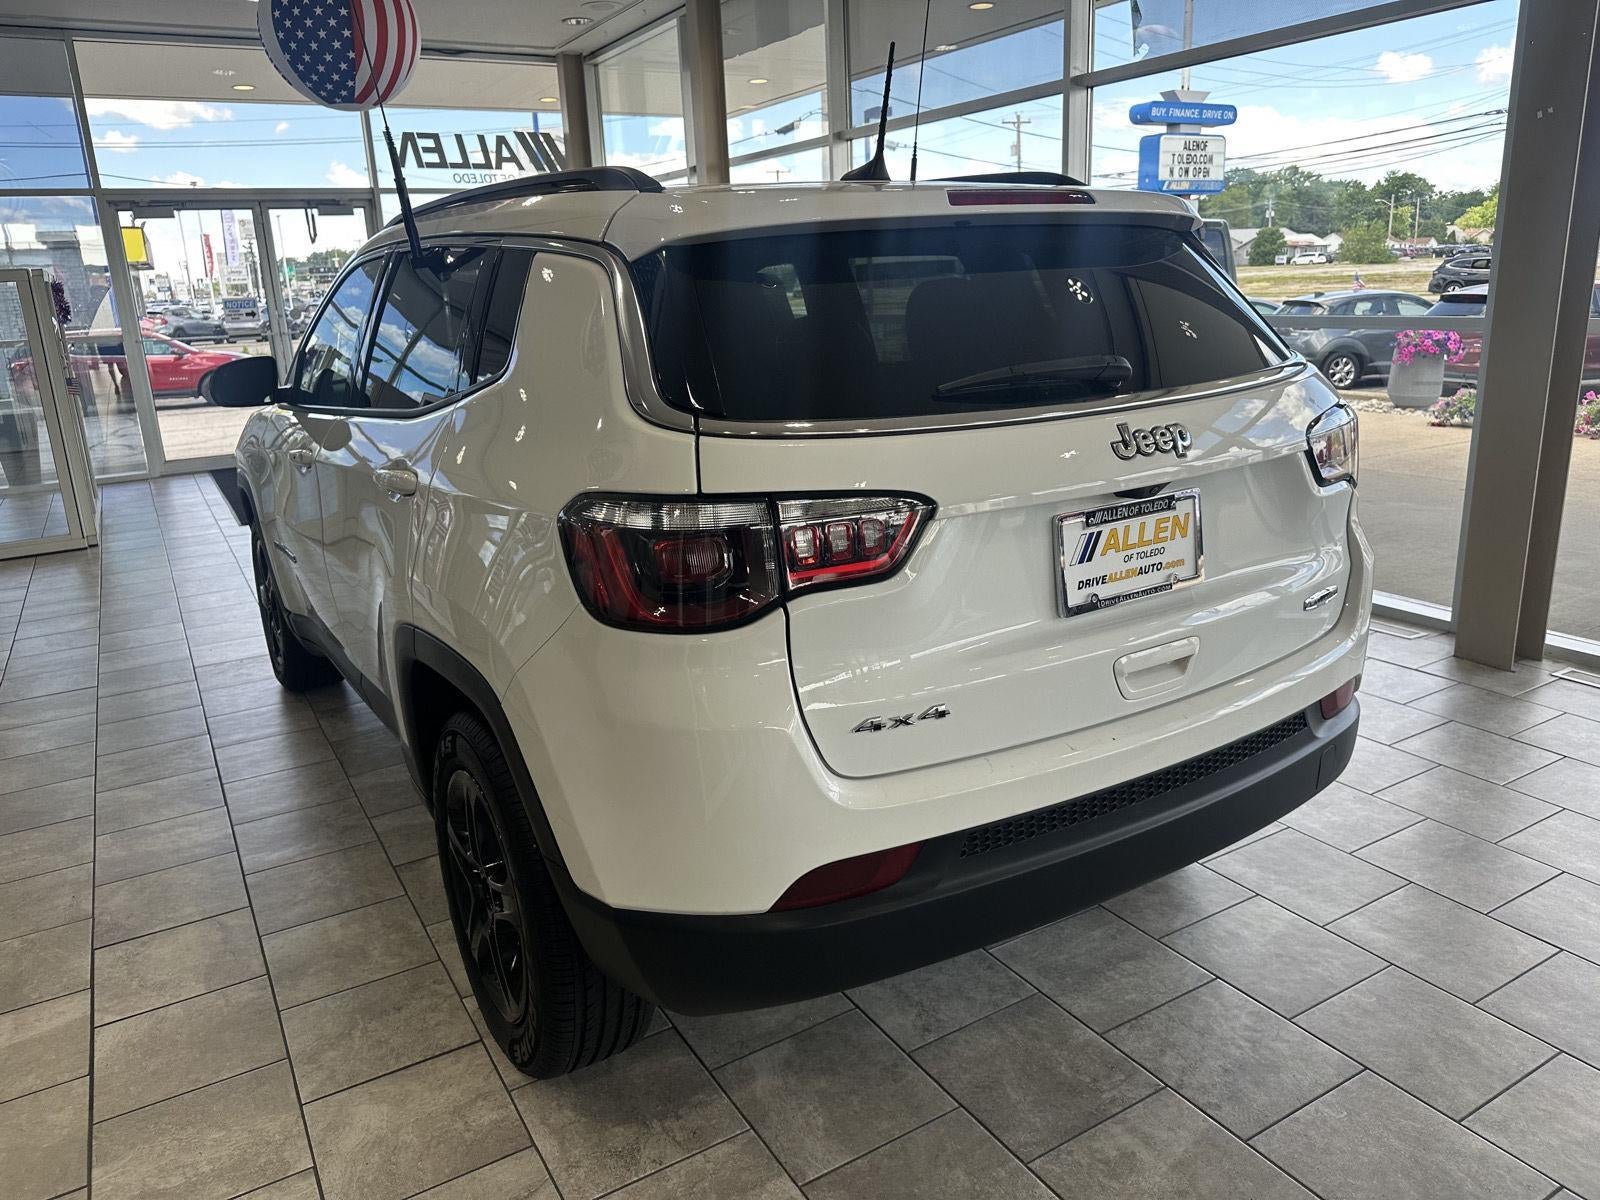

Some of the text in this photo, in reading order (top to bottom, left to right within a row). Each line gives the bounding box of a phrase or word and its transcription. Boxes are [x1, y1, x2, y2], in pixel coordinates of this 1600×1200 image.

[1151, 107, 1167, 117] BUY.
[1169, 107, 1200, 118] FINANCE.
[1202, 109, 1223, 119] DRIVE
[1192, 167, 1210, 178] OPEN
[226, 301, 255, 309] NOTICE
[1110, 422, 1192, 460] Jeep
[1102, 499, 1169, 522] ALLEN OF TOLEDO
[1100, 512, 1190, 557] ALLEN
[1123, 546, 1166, 563] OF TOLEDO
